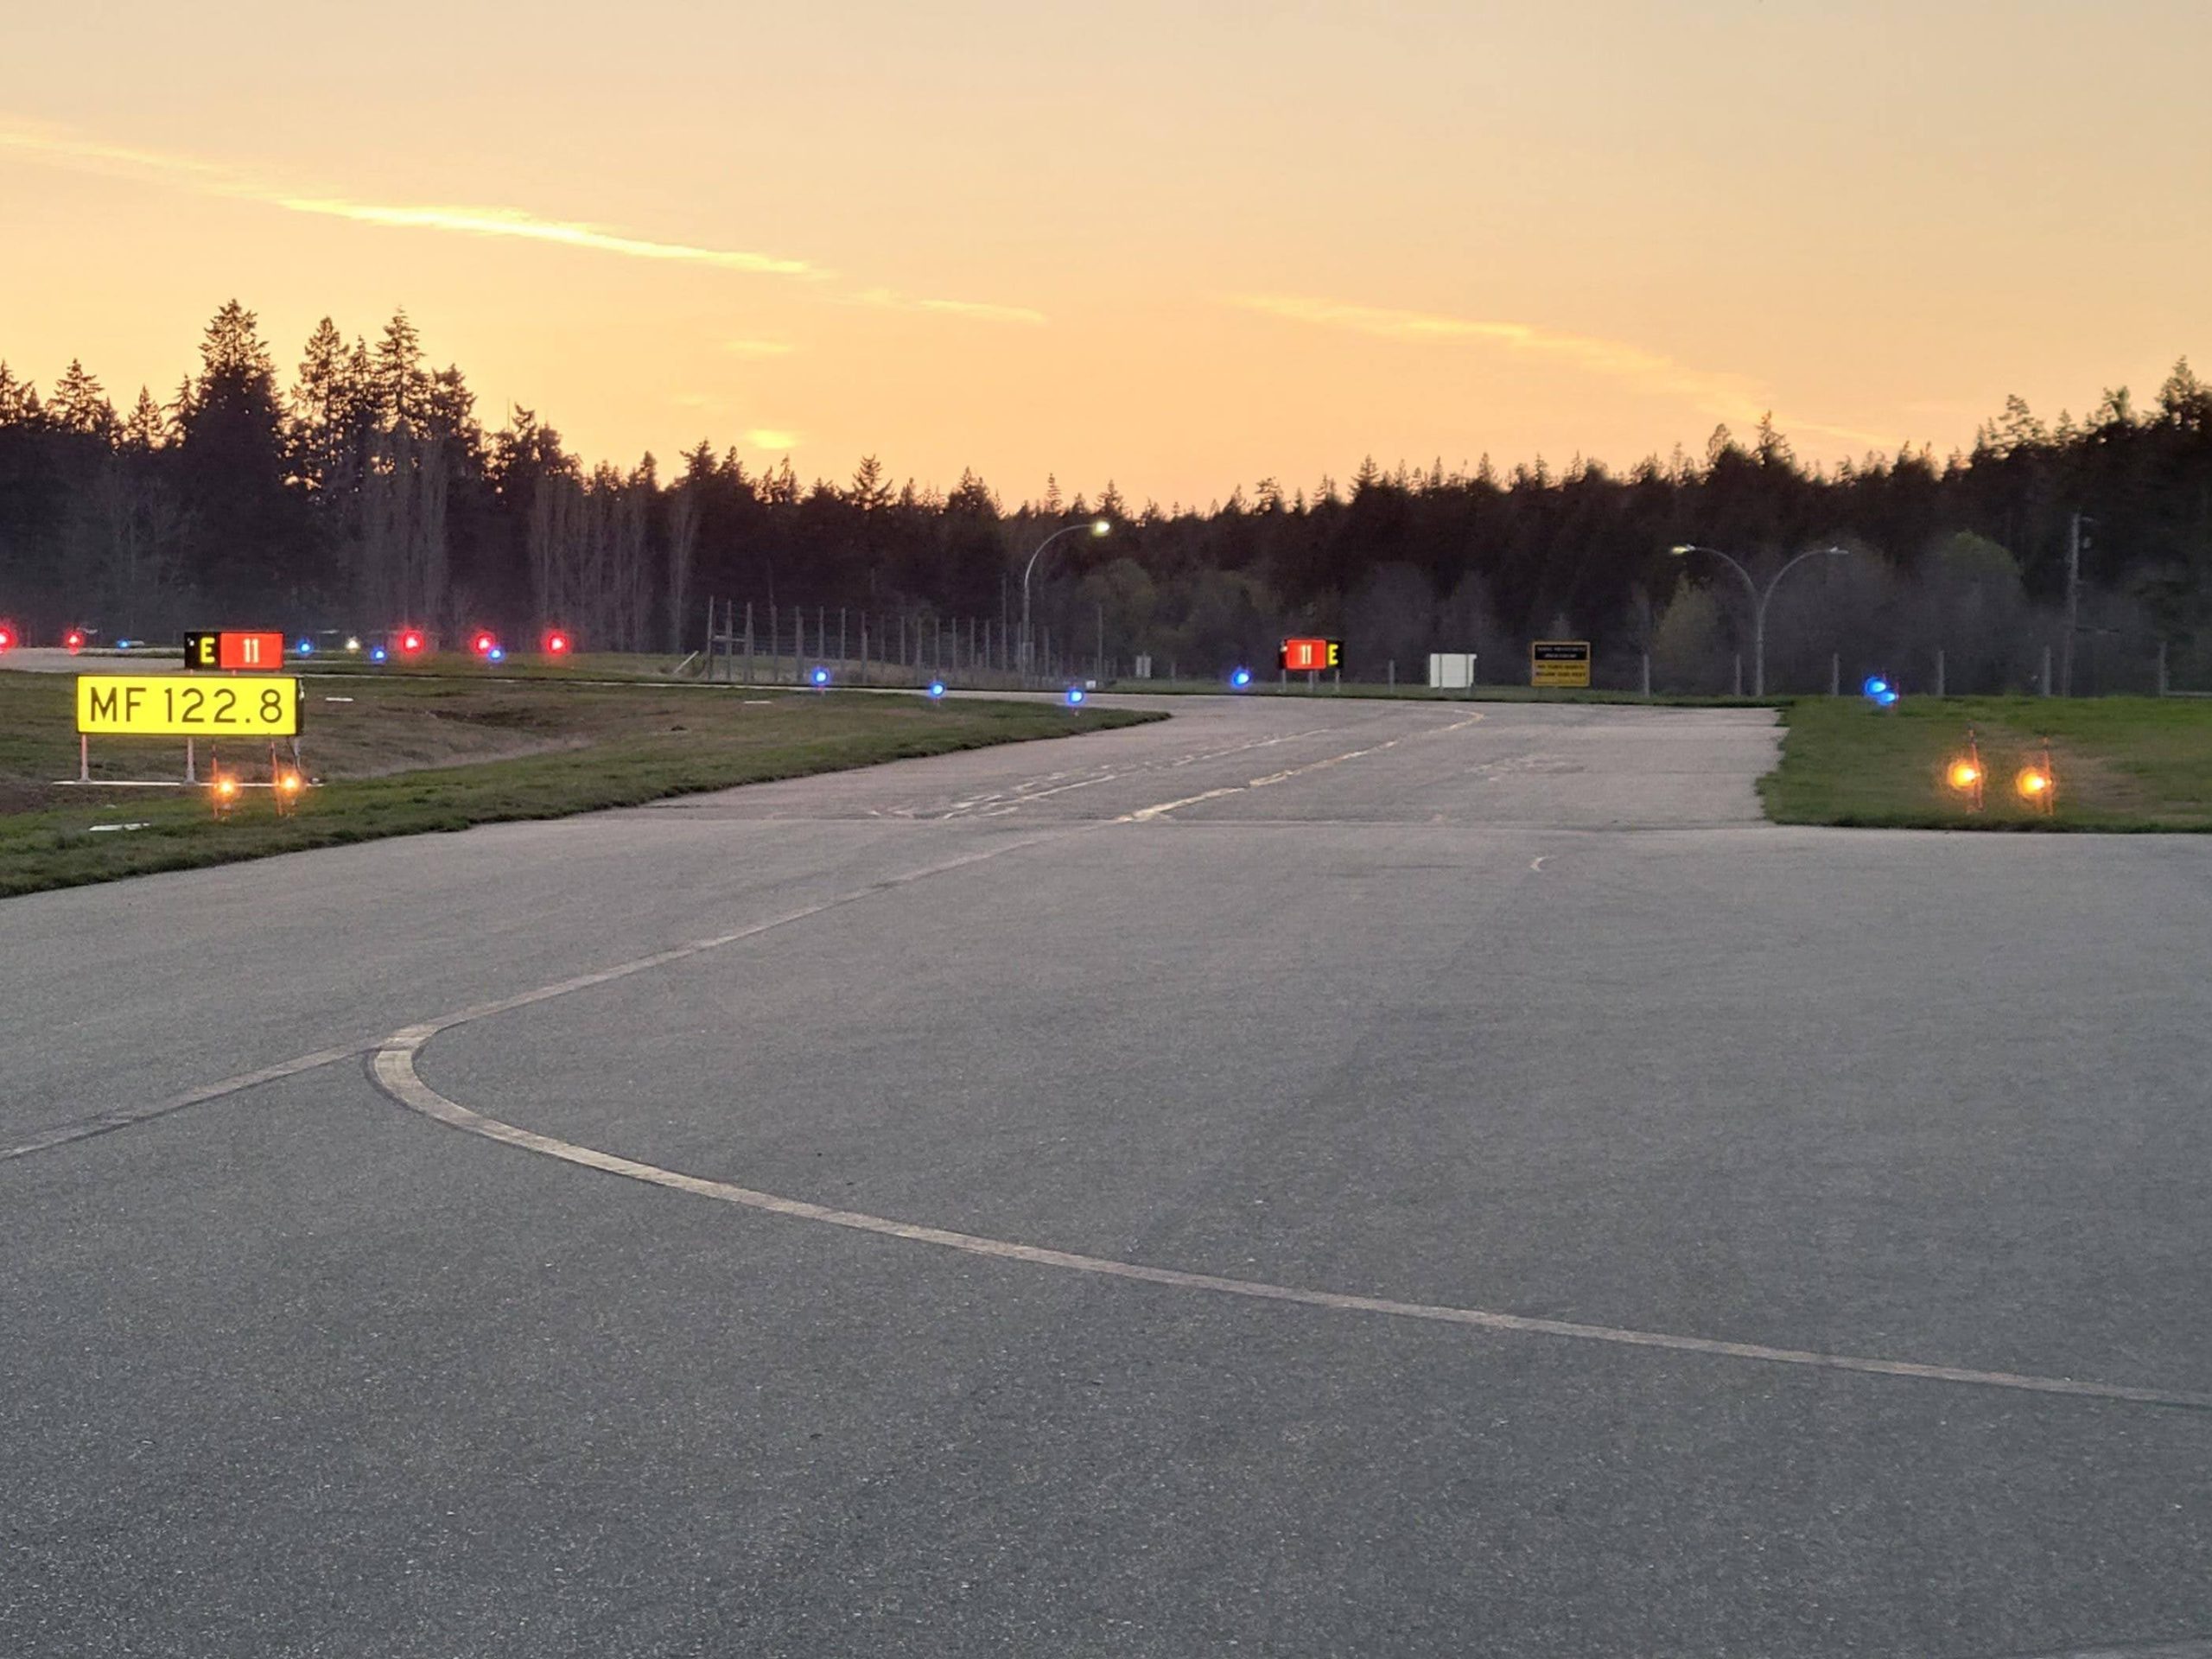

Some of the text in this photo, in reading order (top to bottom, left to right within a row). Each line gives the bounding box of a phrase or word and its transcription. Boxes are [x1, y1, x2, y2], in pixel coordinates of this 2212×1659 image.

[200, 637, 259, 663] E 11
[1301, 644, 1338, 665] 11 E
[91, 687, 283, 724] MF 122.8
